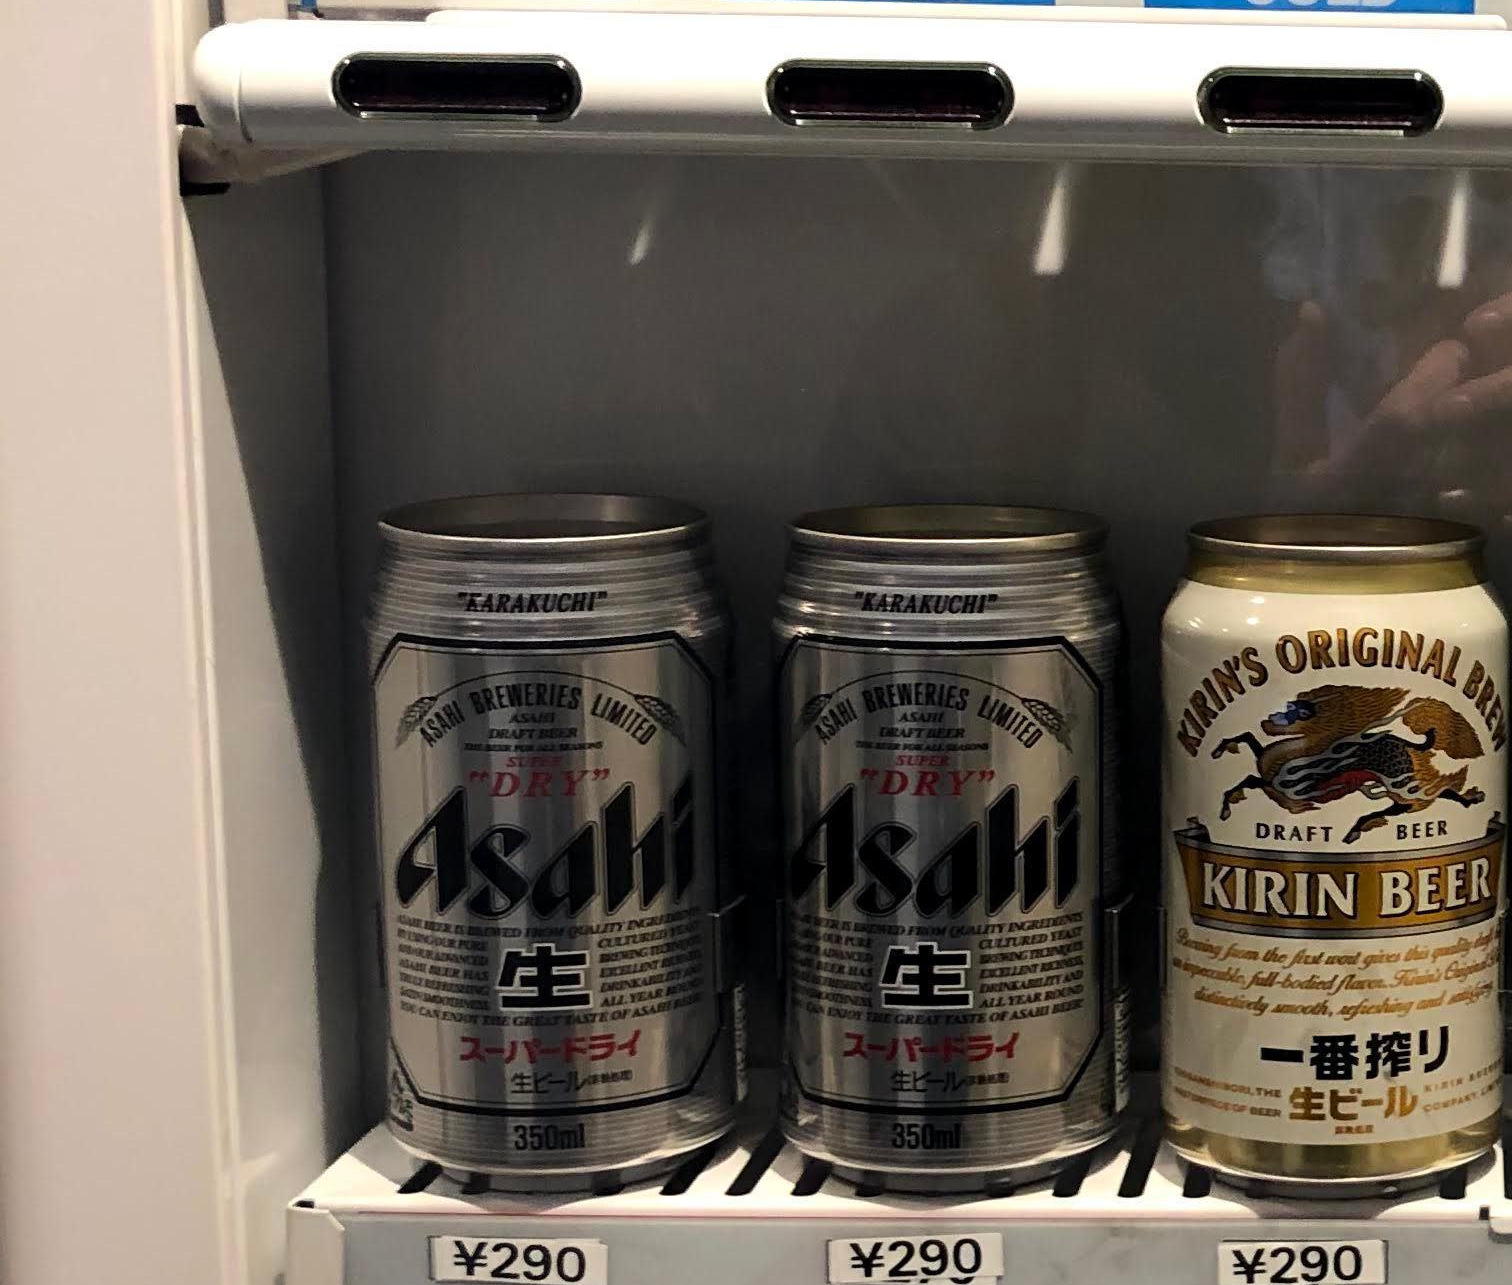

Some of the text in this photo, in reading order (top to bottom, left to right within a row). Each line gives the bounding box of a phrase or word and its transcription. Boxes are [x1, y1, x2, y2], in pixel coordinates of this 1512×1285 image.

[468, 683, 658, 746] BREWERIES LIMITED
[815, 682, 1044, 749] ASAHI BREWERIES LIMITED
[1177, 647, 1269, 758] KIRIN'S
[1275, 627, 1461, 687] ORIGINAL
[396, 771, 696, 917] Asahi
[791, 776, 1080, 917] Asahi
[1255, 821, 1448, 842] DRAFT BEER
[1203, 857, 1491, 919] KIRIN BEER
[496, 942, 594, 1012] 生
[880, 941, 973, 1011] 生
[460, 1029, 641, 1065] スーパードライ
[842, 1032, 1020, 1063] スーパードライ
[1260, 1025, 1450, 1081] 一番搾り
[1289, 1086, 1419, 1121] 生ビール
[514, 1123, 586, 1150] 350ml
[892, 1123, 962, 1150] 350ml
[453, 1240, 588, 1283] ¥290
[850, 1238, 983, 1278] ¥290
[1232, 1246, 1363, 1285] ¥290
